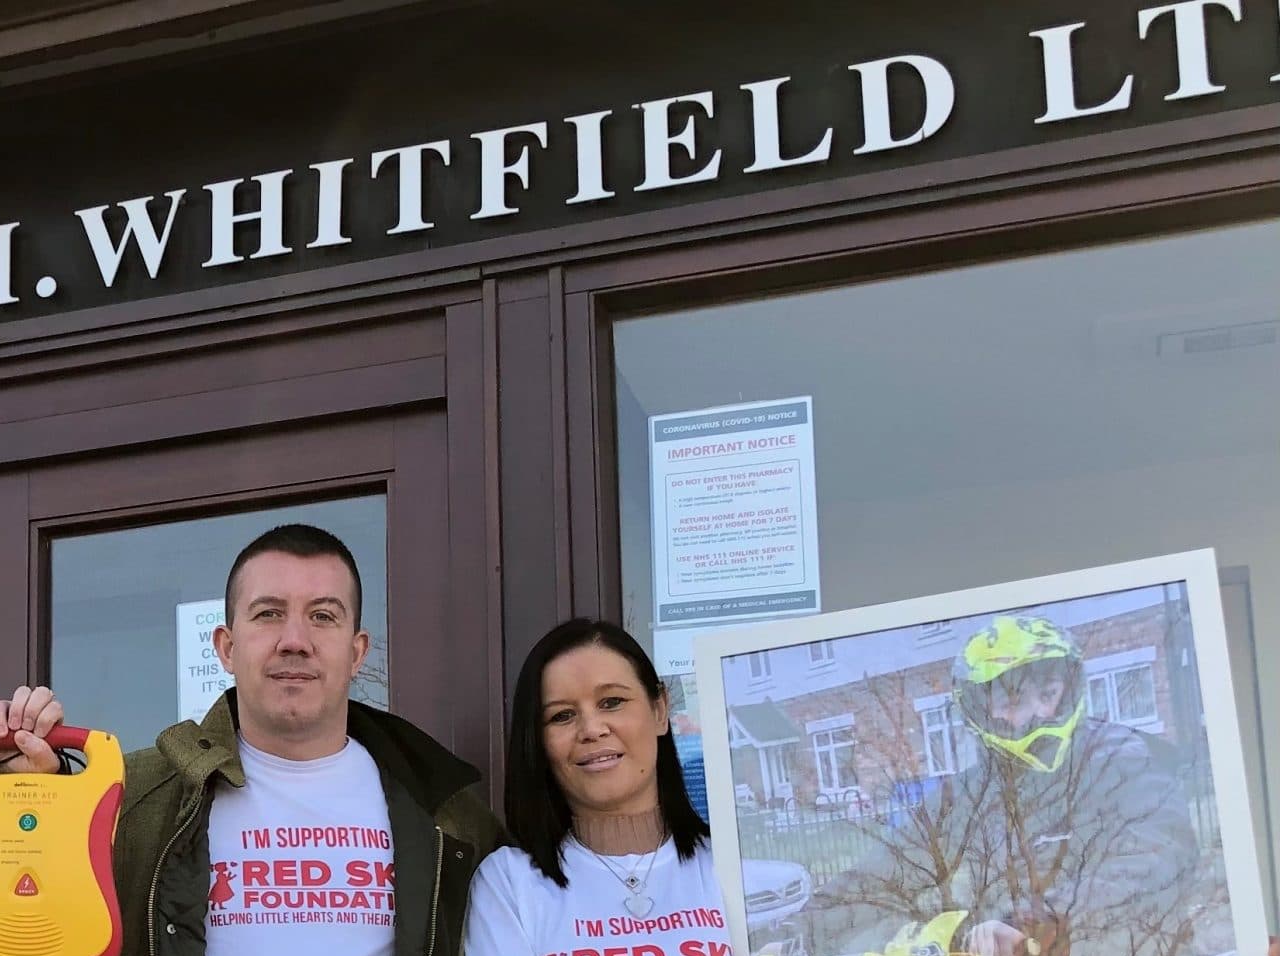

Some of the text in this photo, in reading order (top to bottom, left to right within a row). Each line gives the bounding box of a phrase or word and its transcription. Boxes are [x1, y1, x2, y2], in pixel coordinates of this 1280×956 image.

[1029, 0, 1280, 125] LT
[663, 422, 720, 434] CORONAVIRUS
[768, 411, 797, 421] NOTICE
[668, 435, 796, 460] IMPORTANT NOTICE
[686, 467, 794, 487] NOT ENTER THIS PHARMACY
[715, 483, 732, 491] YOU
[672, 525, 711, 534] YOURSELF
[726, 521, 749, 529] HOME
[776, 515, 797, 523] DAYS
[680, 516, 709, 524] RETURN
[712, 513, 735, 521] HOME
[758, 507, 789, 517] ISOLATE
[729, 549, 759, 558] ONLINE
[762, 545, 795, 554] SERVICE
[709, 559, 728, 567] CALL
[189, 664, 219, 678] THIS
[203, 680, 227, 693] IT'S
[242, 826, 390, 850] I'M SUPPORTING
[242, 860, 395, 887] RED SK
[244, 891, 395, 910] FOUNDATI
[210, 913, 253, 927] HELPING
[255, 912, 289, 924] LITTLE
[293, 911, 333, 924] HEARTS
[336, 912, 358, 924] AND
[361, 914, 390, 926] THEIR
[575, 907, 725, 937] I'M SUPPORTING
